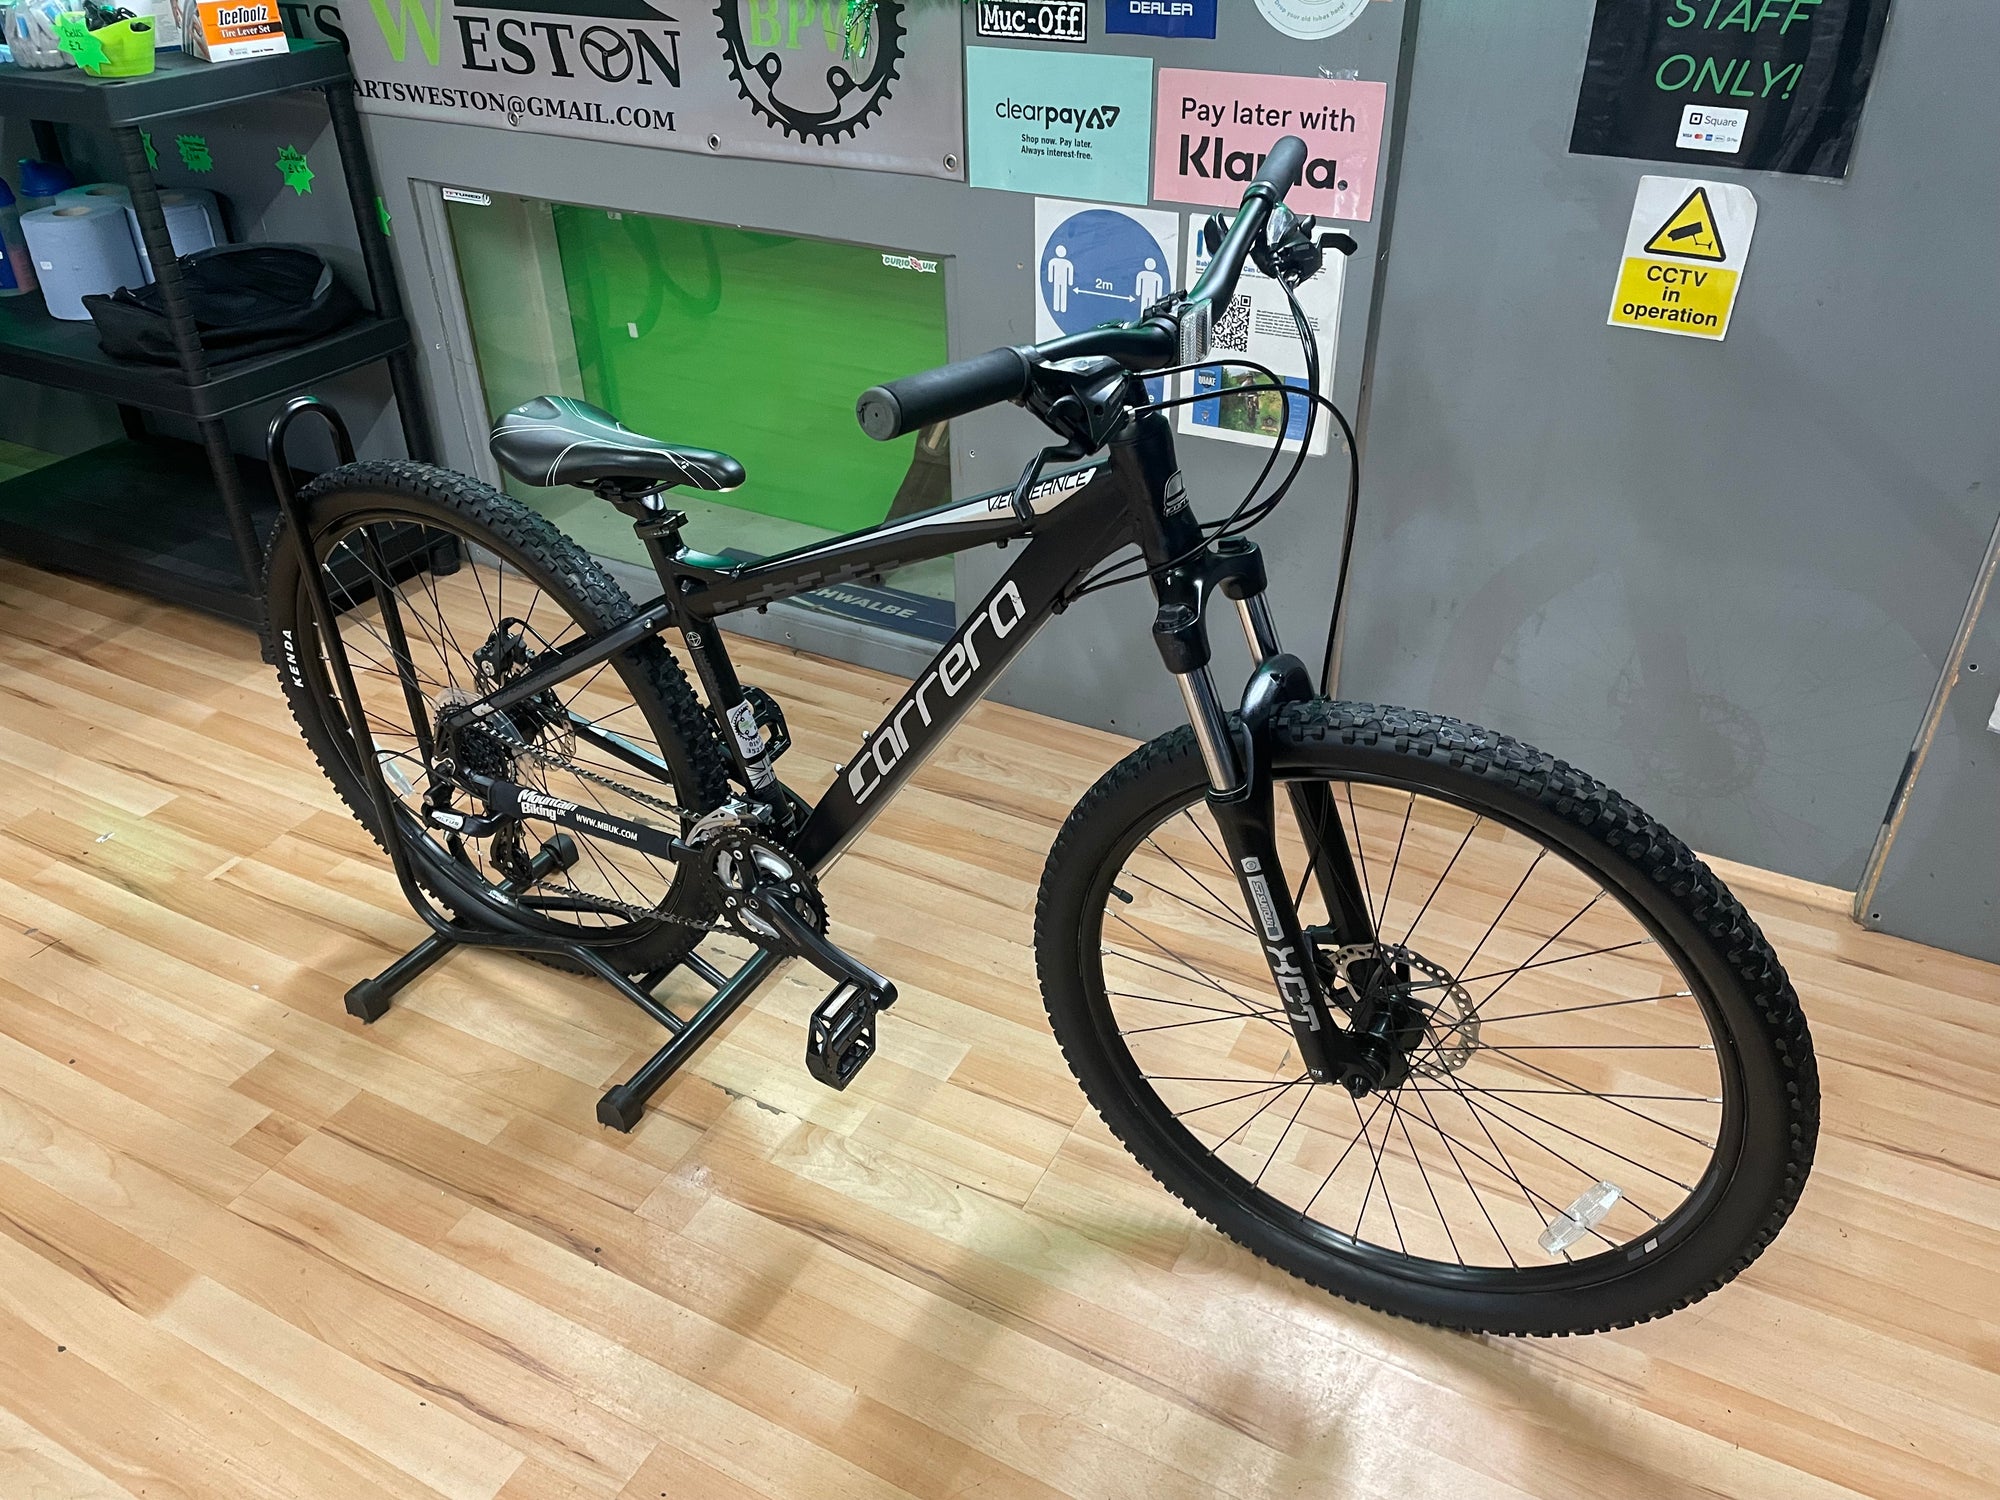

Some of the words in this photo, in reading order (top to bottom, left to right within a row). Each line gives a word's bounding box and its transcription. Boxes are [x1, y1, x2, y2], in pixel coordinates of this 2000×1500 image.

[219, 6, 267, 25] IceToolz
[983, 5, 1081, 36] Muc-Off
[1130, 1, 1193, 16] DEALER
[1666, 0, 1823, 35] STAFF
[220, 29, 236, 38] Tire
[237, 27, 258, 36] Lever
[258, 25, 271, 34] Set
[1655, 54, 1804, 100] ONLY!
[352, 79, 677, 131] ARTSWESTON@GMAIL.COM
[995, 97, 1087, 133] clearpay
[1181, 97, 1226, 127] Pay
[1233, 100, 1292, 127] later
[1300, 106, 1355, 132] with
[1704, 115, 1738, 127] Square
[1021, 133, 1039, 145] Shop
[1060, 137, 1073, 148] Pay
[1075, 139, 1093, 149] later.
[1021, 145, 1045, 156] Always
[1046, 147, 1093, 160] interest-free.
[1178, 134, 1348, 191] Klaa.
[1095, 278, 1113, 291] 2m
[1647, 265, 1709, 287] CCTV
[1662, 286, 1680, 303] in
[1623, 303, 1718, 327] operation
[282, 629, 304, 688] KENDA
[848, 580, 1026, 804] carrera
[517, 788, 579, 812] Mountain
[521, 801, 557, 821] Biking
[556, 808, 566, 817] UK
[576, 813, 638, 842] WWW.MBUK.COM
[1267, 945, 1321, 1032] XCT
